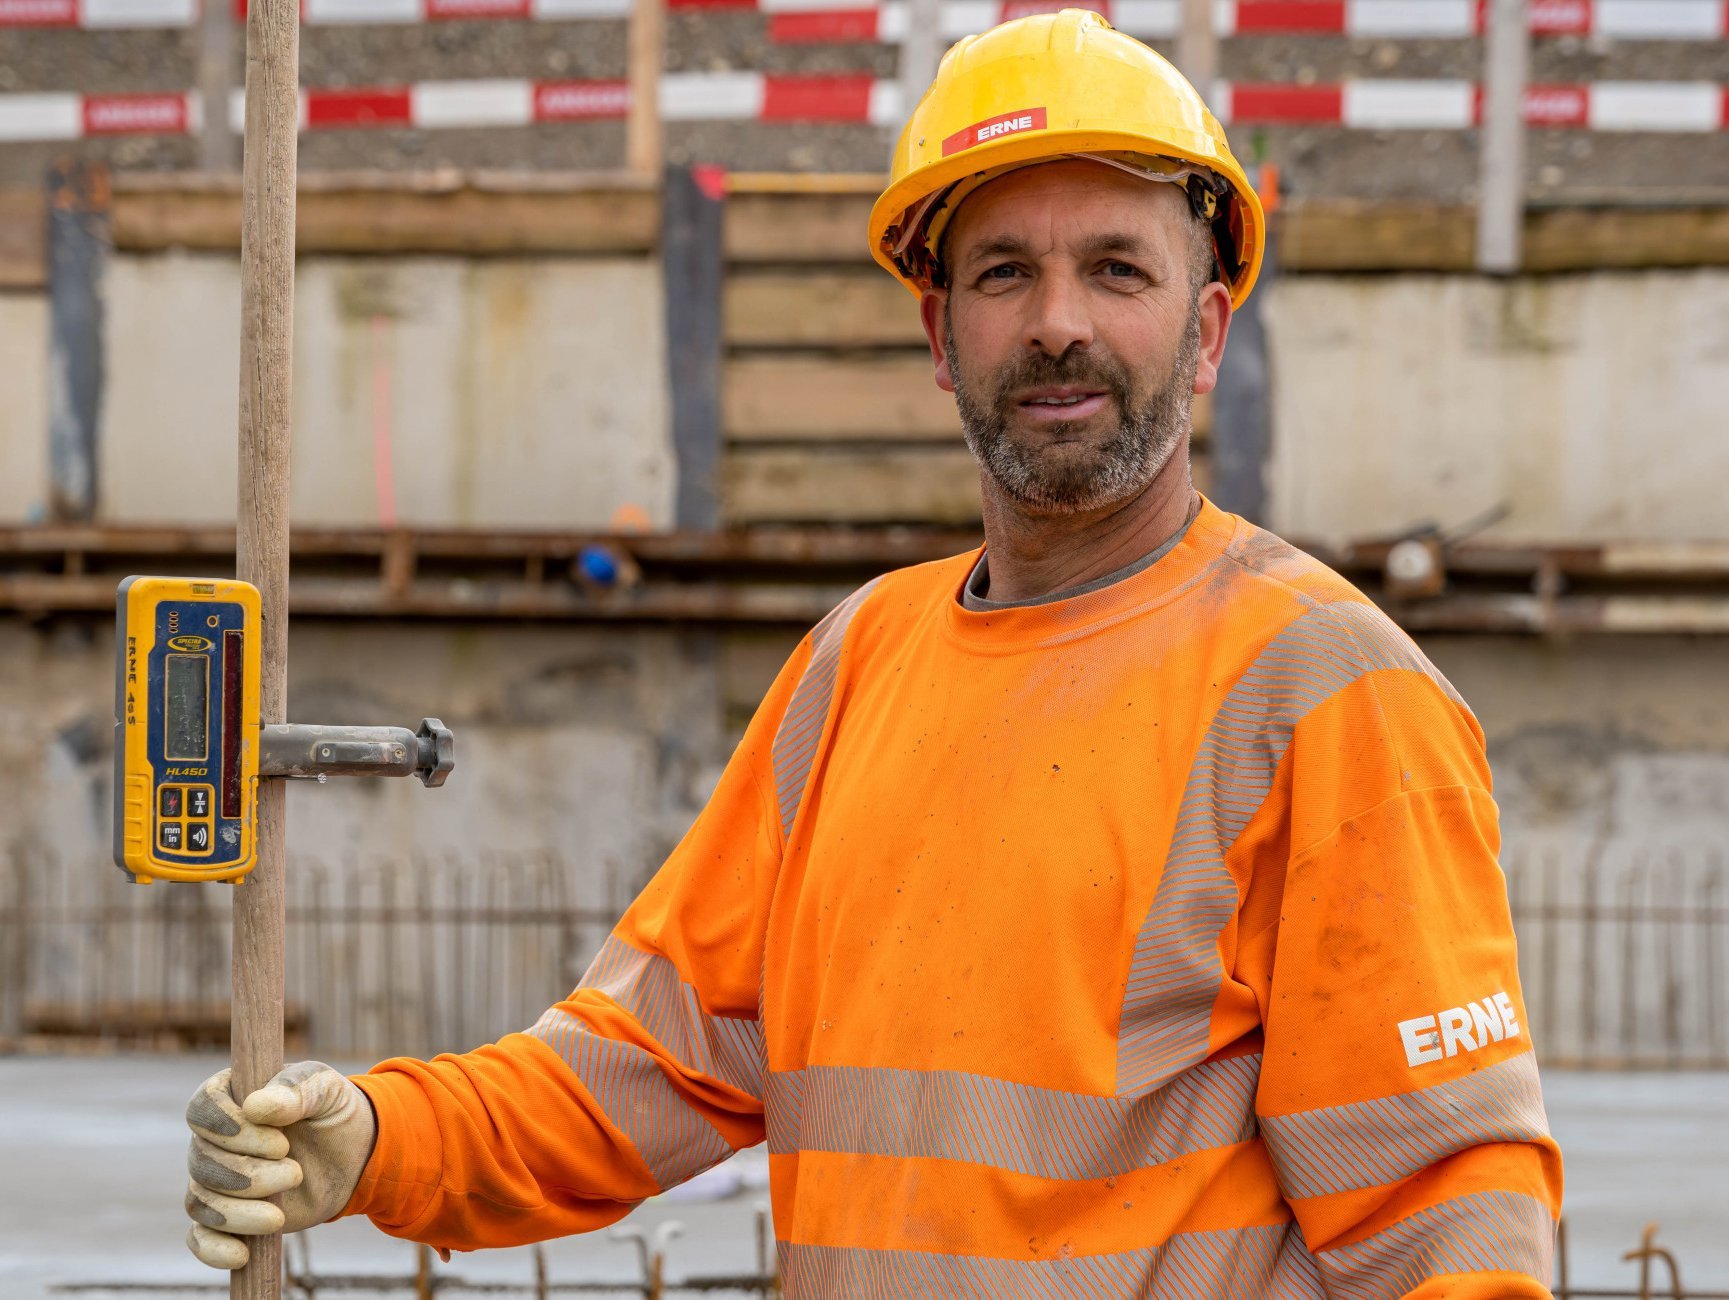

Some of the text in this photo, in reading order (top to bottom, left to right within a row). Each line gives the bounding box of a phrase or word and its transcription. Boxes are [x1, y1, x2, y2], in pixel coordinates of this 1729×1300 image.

[977, 116, 1032, 141] ERNE
[128, 637, 136, 684] ERNE
[165, 767, 208, 776] HL450
[168, 834, 177, 843] in
[1397, 991, 1520, 1068] ERNE
